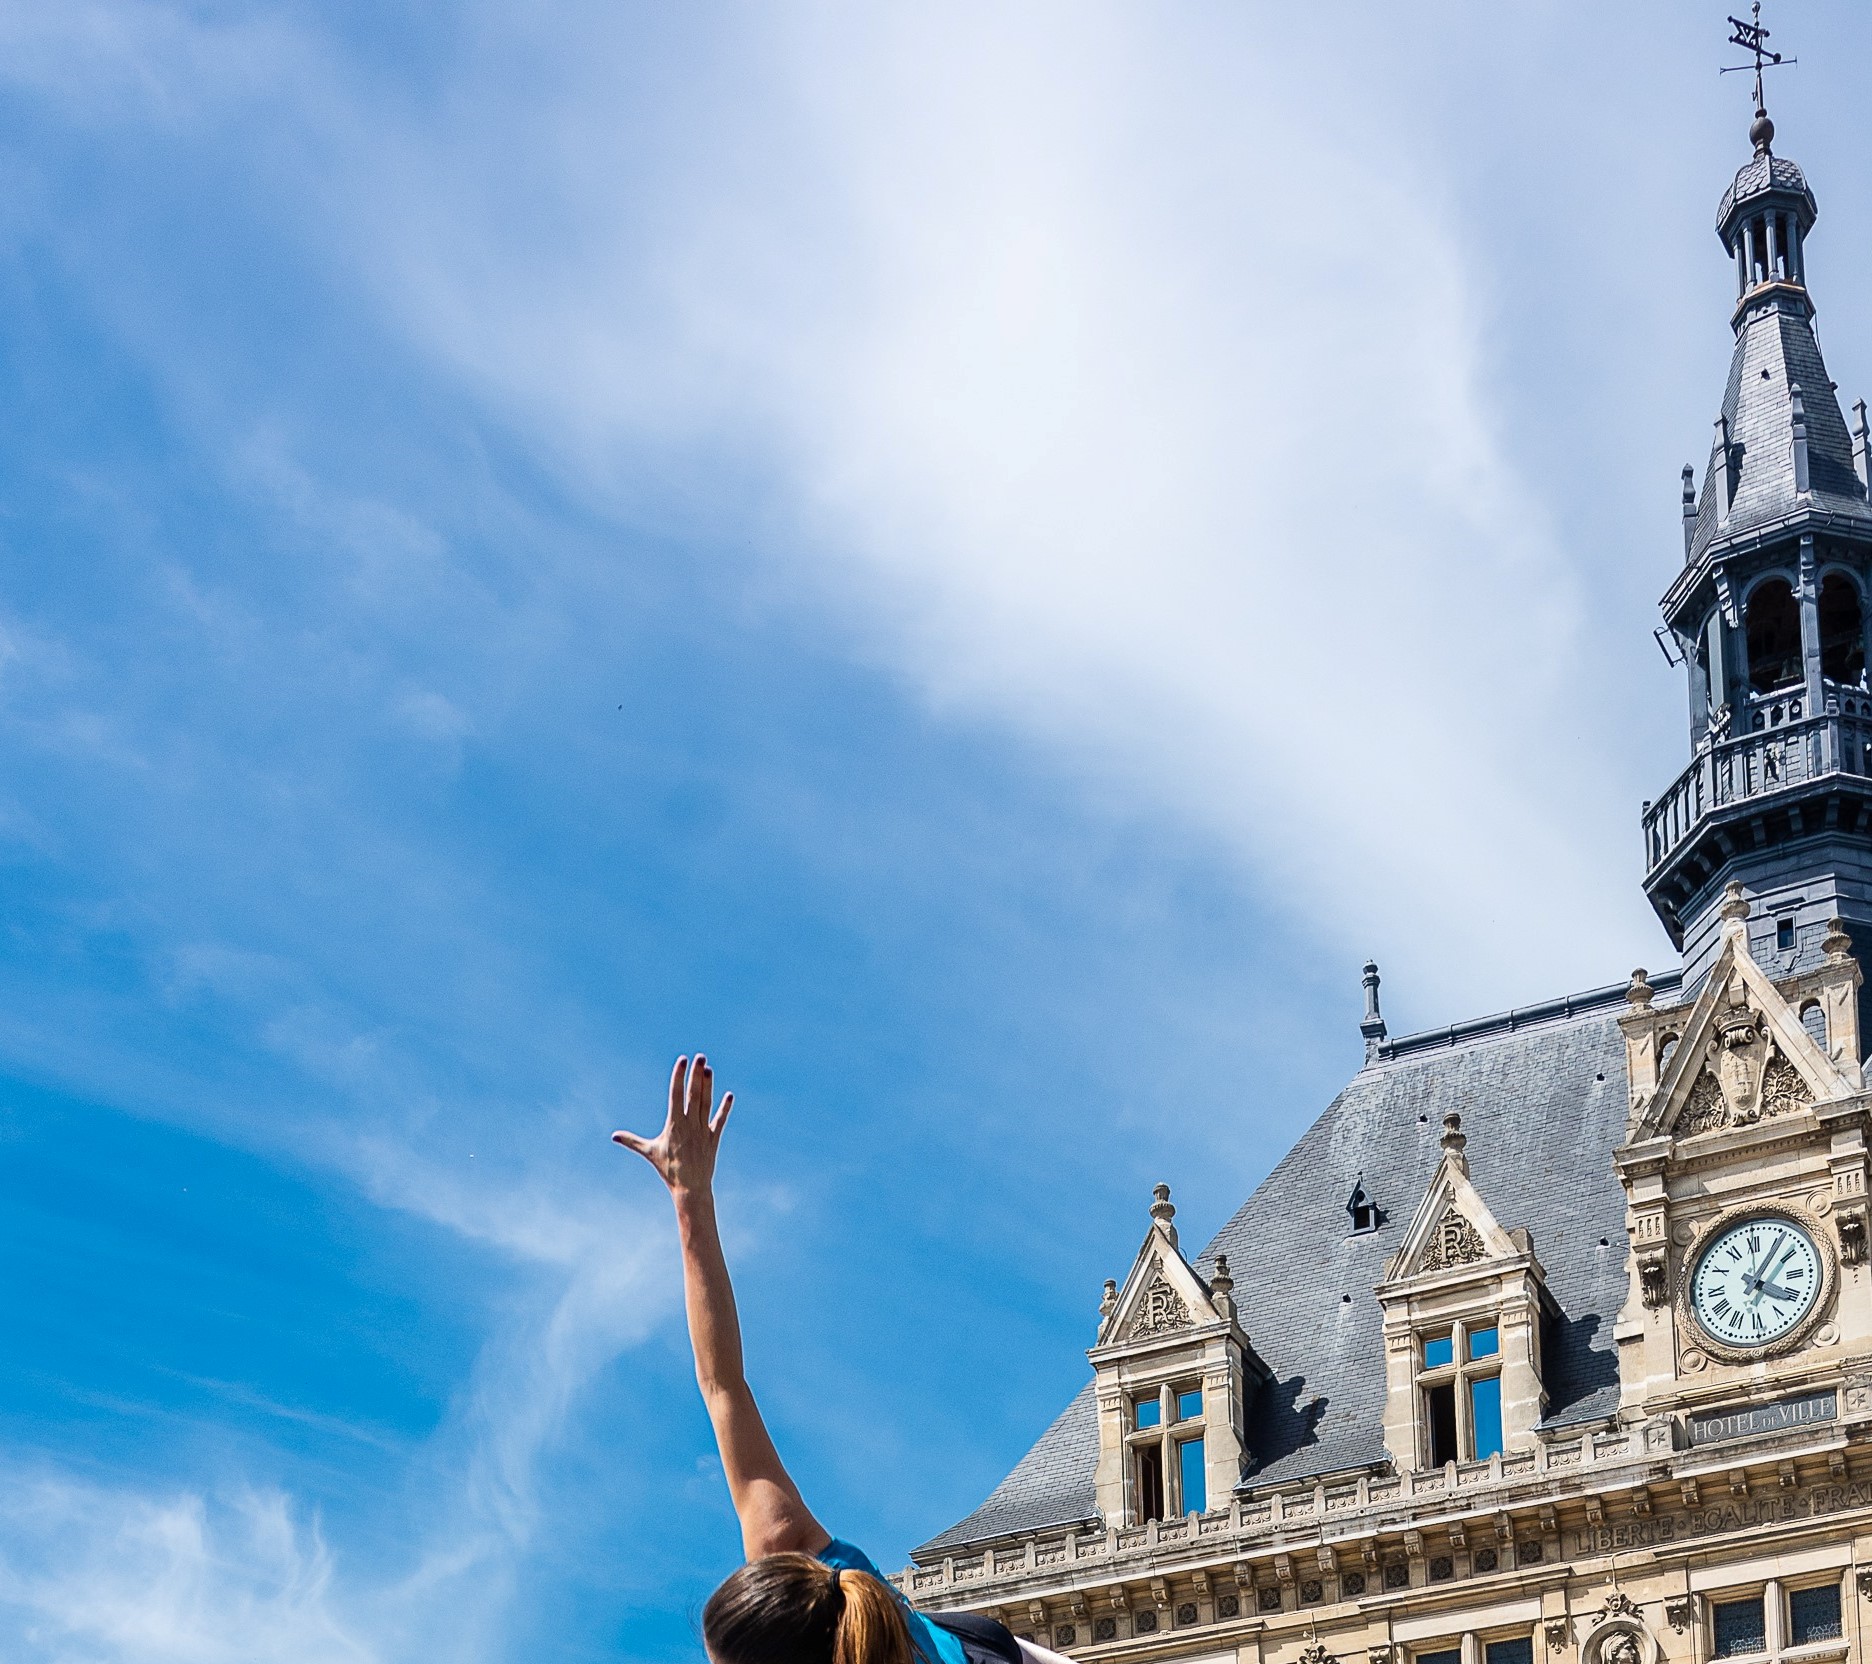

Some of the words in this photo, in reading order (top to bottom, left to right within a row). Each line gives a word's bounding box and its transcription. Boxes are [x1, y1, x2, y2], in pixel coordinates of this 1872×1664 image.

[1712, 1266, 1729, 1276] X
[1772, 1305, 1784, 1319] V
[1694, 1411, 1760, 1440] HOTEL
[1778, 1397, 1832, 1423] VILLE
[1575, 1515, 1673, 1555] LIBERTE
[1690, 1495, 1796, 1534] EGALITE
